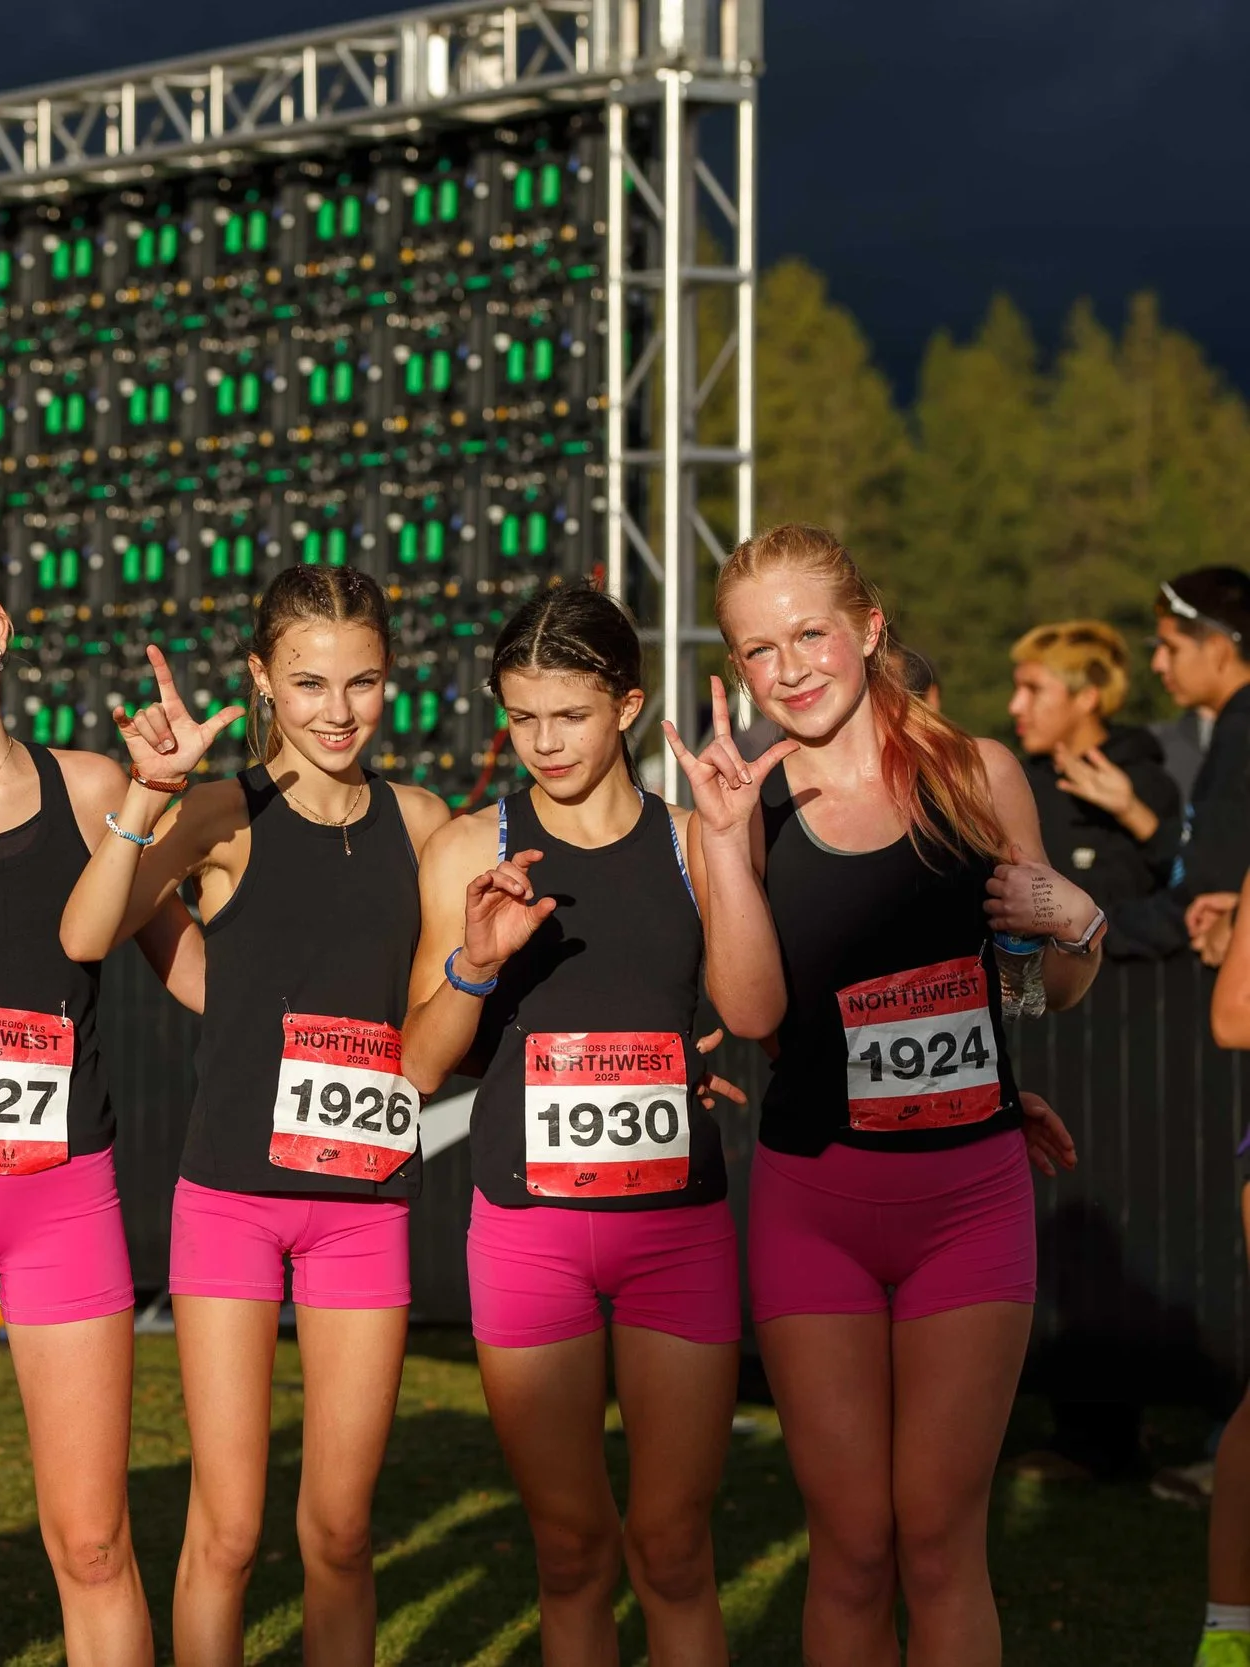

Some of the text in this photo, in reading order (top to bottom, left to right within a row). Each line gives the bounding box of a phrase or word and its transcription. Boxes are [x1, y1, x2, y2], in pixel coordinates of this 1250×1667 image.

[848, 977, 979, 1013] NORTHWEST
[909, 1004, 935, 1015] 2025
[294, 1030, 402, 1061] NORTHWES
[550, 1045, 572, 1053] NIKE
[609, 1044, 659, 1052] REGIONALS
[346, 1055, 370, 1065] 2025
[859, 1025, 990, 1082] 1924
[535, 1054, 674, 1072] NORTHWEST
[594, 1073, 620, 1082] 2025
[290, 1078, 412, 1136] 1926
[538, 1099, 679, 1147] 1930
[321, 1148, 341, 1158] RUN
[578, 1172, 598, 1181] RUN
